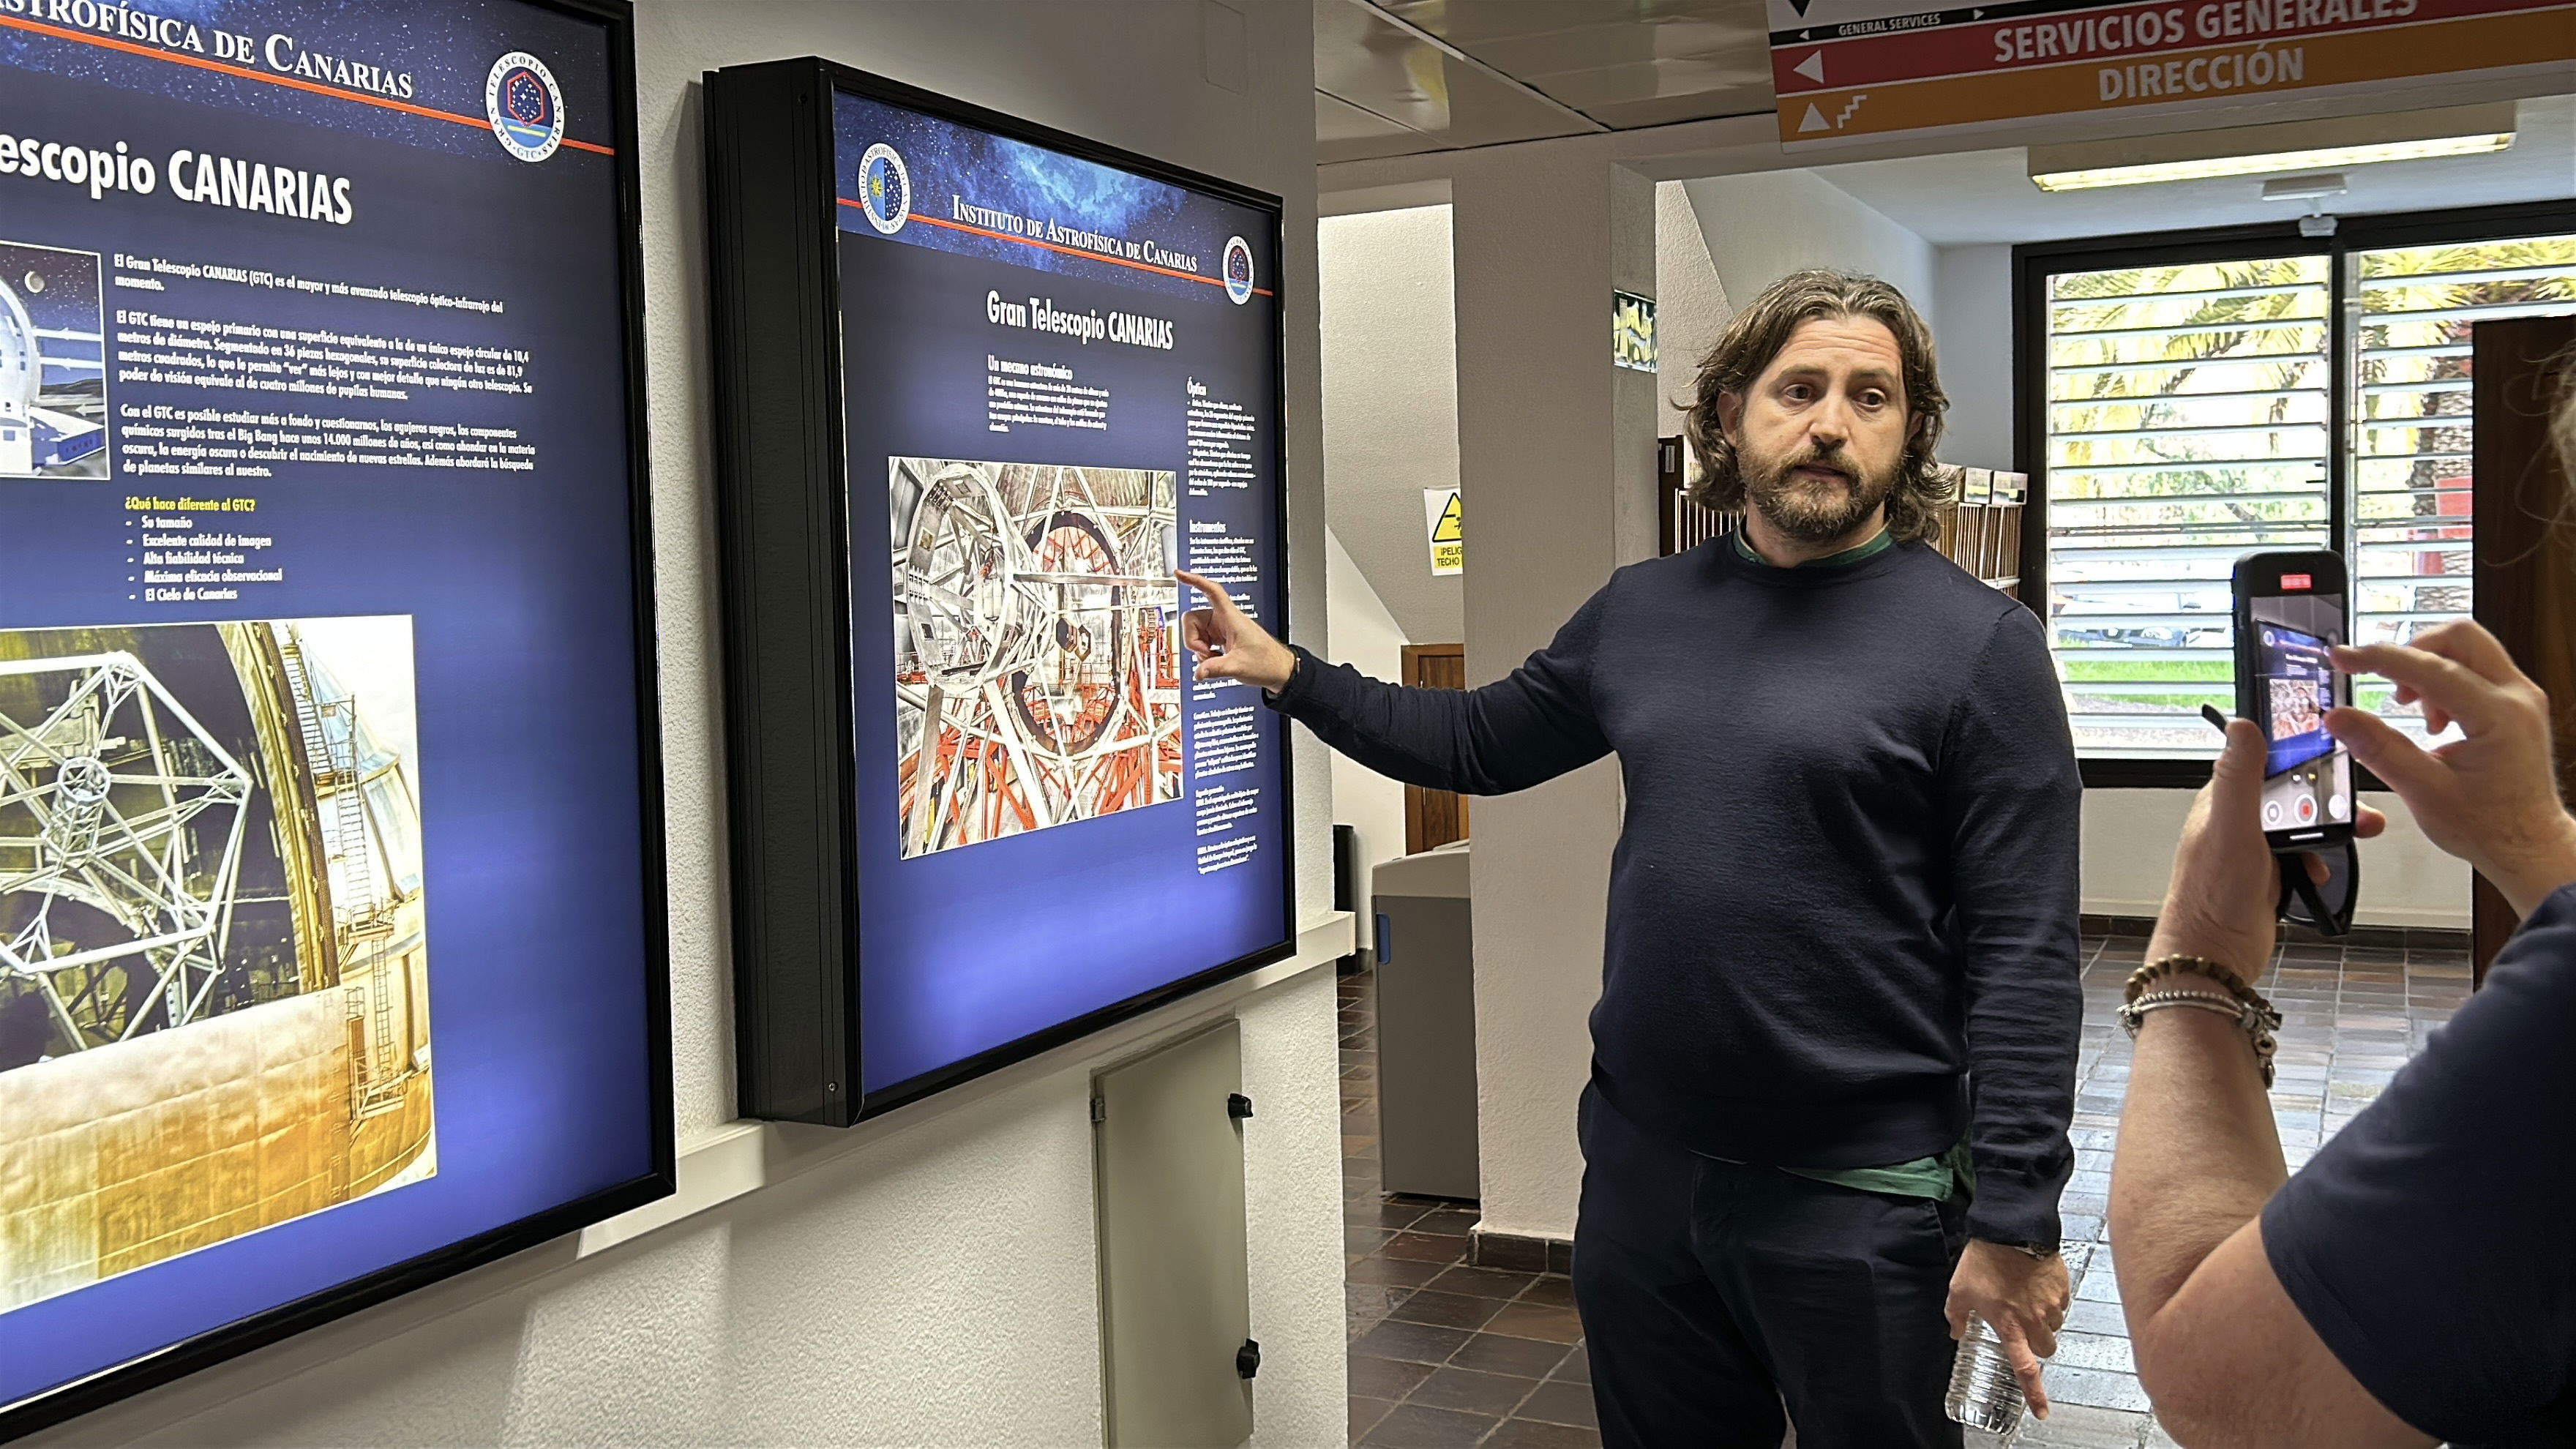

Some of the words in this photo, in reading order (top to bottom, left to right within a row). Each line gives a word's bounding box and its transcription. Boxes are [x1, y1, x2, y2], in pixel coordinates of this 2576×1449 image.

[1838, 20, 1888, 36] GENERAL
[1889, 13, 1941, 30] SERVICES
[1993, 7, 2185, 63] SERVICIOS
[213, 29, 255, 64] DE
[265, 34, 413, 99] CANARIAS
[2098, 42, 2304, 102] DIRECCIÓN
[489, 56, 547, 97] TELESCOPIO
[543, 83, 562, 155] CANARIAS
[517, 149, 537, 159] GTC
[168, 149, 353, 225] CANARIAS
[952, 194, 1023, 234] INSTITUTO
[1026, 218, 1044, 238] DE
[1046, 217, 1123, 257] ASTROFÍSICA
[1126, 242, 1141, 260] DE
[1143, 240, 1197, 272] CANARIAS
[114, 254, 124, 267] El
[127, 255, 150, 270] Gran
[152, 258, 201, 278] Telescopio
[203, 266, 247, 282] CANARIAS
[250, 271, 273, 288] (GTC)
[297, 280, 323, 293] mayor
[332, 282, 348, 294] más
[351, 287, 388, 299] avanzado
[491, 301, 503, 312] del
[115, 277, 164, 291] momento.
[116, 310, 127, 323] El
[129, 312, 148, 326] GTC
[150, 315, 174, 328] tiene
[190, 321, 221, 335] espejo
[223, 323, 261, 337] primario
[263, 329, 278, 338] con
[987, 290, 1026, 328] Gran
[1029, 297, 1105, 345] Telescopio
[1108, 312, 1173, 350] CANARIAS
[118, 332, 151, 344] metros
[284, 344, 295, 357] 36
[297, 347, 323, 360] piezas
[119, 351, 151, 362] metros
[154, 352, 205, 369] cuadrados,
[248, 361, 282, 373] permite
[310, 364, 326, 376] más
[329, 365, 348, 381] lejos
[356, 371, 370, 380] con
[372, 371, 395, 384] mejor
[397, 371, 423, 384] detalle
[119, 367, 149, 382] poder
[165, 371, 192, 383] visión
[195, 374, 233, 388] equivale
[260, 380, 287, 391] cuatro
[289, 380, 324, 394] millones
[339, 384, 368, 398] pupilas
[370, 385, 408, 400] humanas.
[120, 404, 140, 417] Con
[154, 406, 173, 419] GTC
[187, 408, 221, 423] posible
[223, 411, 259, 424] estudiar
[261, 413, 279, 424] más
[289, 413, 313, 427] fondo
[381, 419, 392, 431] los
[394, 422, 427, 435] agujeros
[121, 423, 164, 438] químicos
[166, 425, 206, 441] surgidos
[208, 429, 225, 440] tras
[238, 429, 252, 444] Big
[255, 430, 277, 445] Bang
[280, 430, 299, 443] hace
[302, 435, 321, 444] unos
[353, 435, 386, 447] millones
[400, 438, 421, 451] años,
[122, 445, 157, 457] oscura,
[171, 444, 206, 460] energía
[209, 449, 237, 457] oscura
[248, 446, 288, 460] descubrir
[300, 450, 345, 463] nacimiento
[359, 455, 386, 464] nuevas
[389, 453, 423, 465] estrellas.
[138, 460, 179, 476] planetas
[181, 462, 223, 475] similares
[236, 466, 272, 476] nuestro.
[125, 497, 151, 509] ¿Qué
[153, 496, 176, 510] hace
[178, 498, 219, 511] diferente
[233, 499, 255, 512] GTC?
[142, 515, 154, 528] Su
[156, 517, 192, 528] tamaño
[143, 533, 187, 546] Excelente
[189, 533, 222, 546] calidad
[238, 535, 272, 550] imagen
[143, 551, 163, 564] Alta
[165, 551, 211, 564] fiabilidad
[212, 552, 244, 564] técnica
[1437, 557, 1460, 566] TECHO
[144, 570, 183, 583] Máxima
[185, 569, 220, 583] eficacia
[222, 568, 282, 582] observacional
[146, 588, 154, 601] El
[157, 588, 181, 601] Cielo
[197, 588, 237, 599] Canarias
